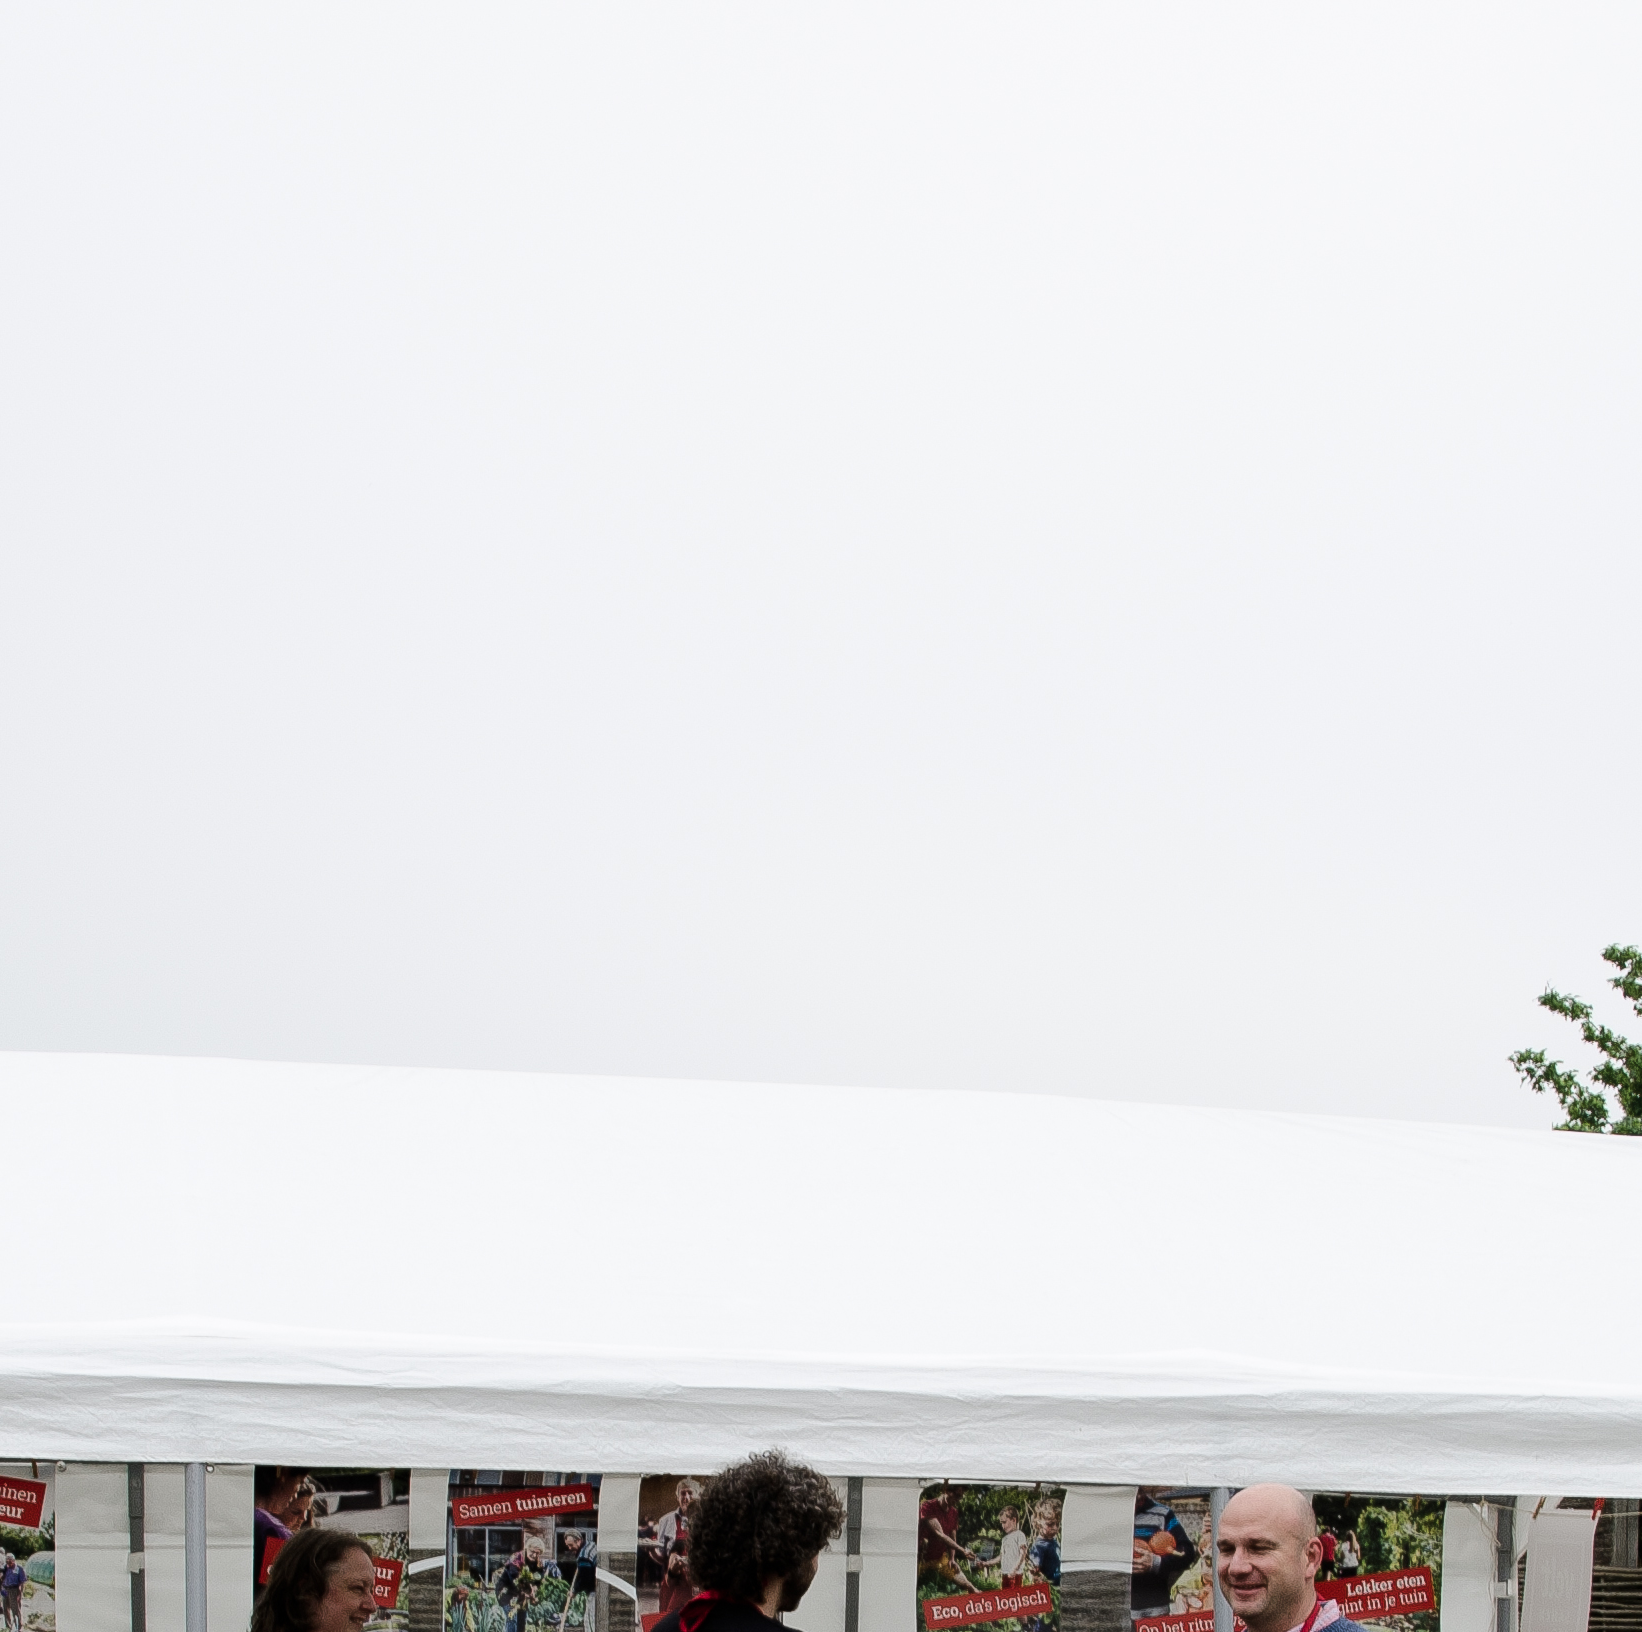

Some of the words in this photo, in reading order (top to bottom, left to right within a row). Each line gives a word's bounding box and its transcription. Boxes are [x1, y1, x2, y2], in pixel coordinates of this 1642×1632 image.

[459, 1501, 512, 1519] Samen
[516, 1492, 587, 1512] tuinieren
[1346, 1579, 1394, 1597] Lekker
[1396, 1575, 1426, 1590] eten
[931, 1605, 963, 1620] Eco,
[966, 1598, 992, 1616] da's
[995, 1590, 1047, 1612] logisch
[1338, 1598, 1364, 1616] gint
[1367, 1595, 1382, 1611] in
[1384, 1593, 1396, 1611] je
[1399, 1589, 1428, 1606] tuin
